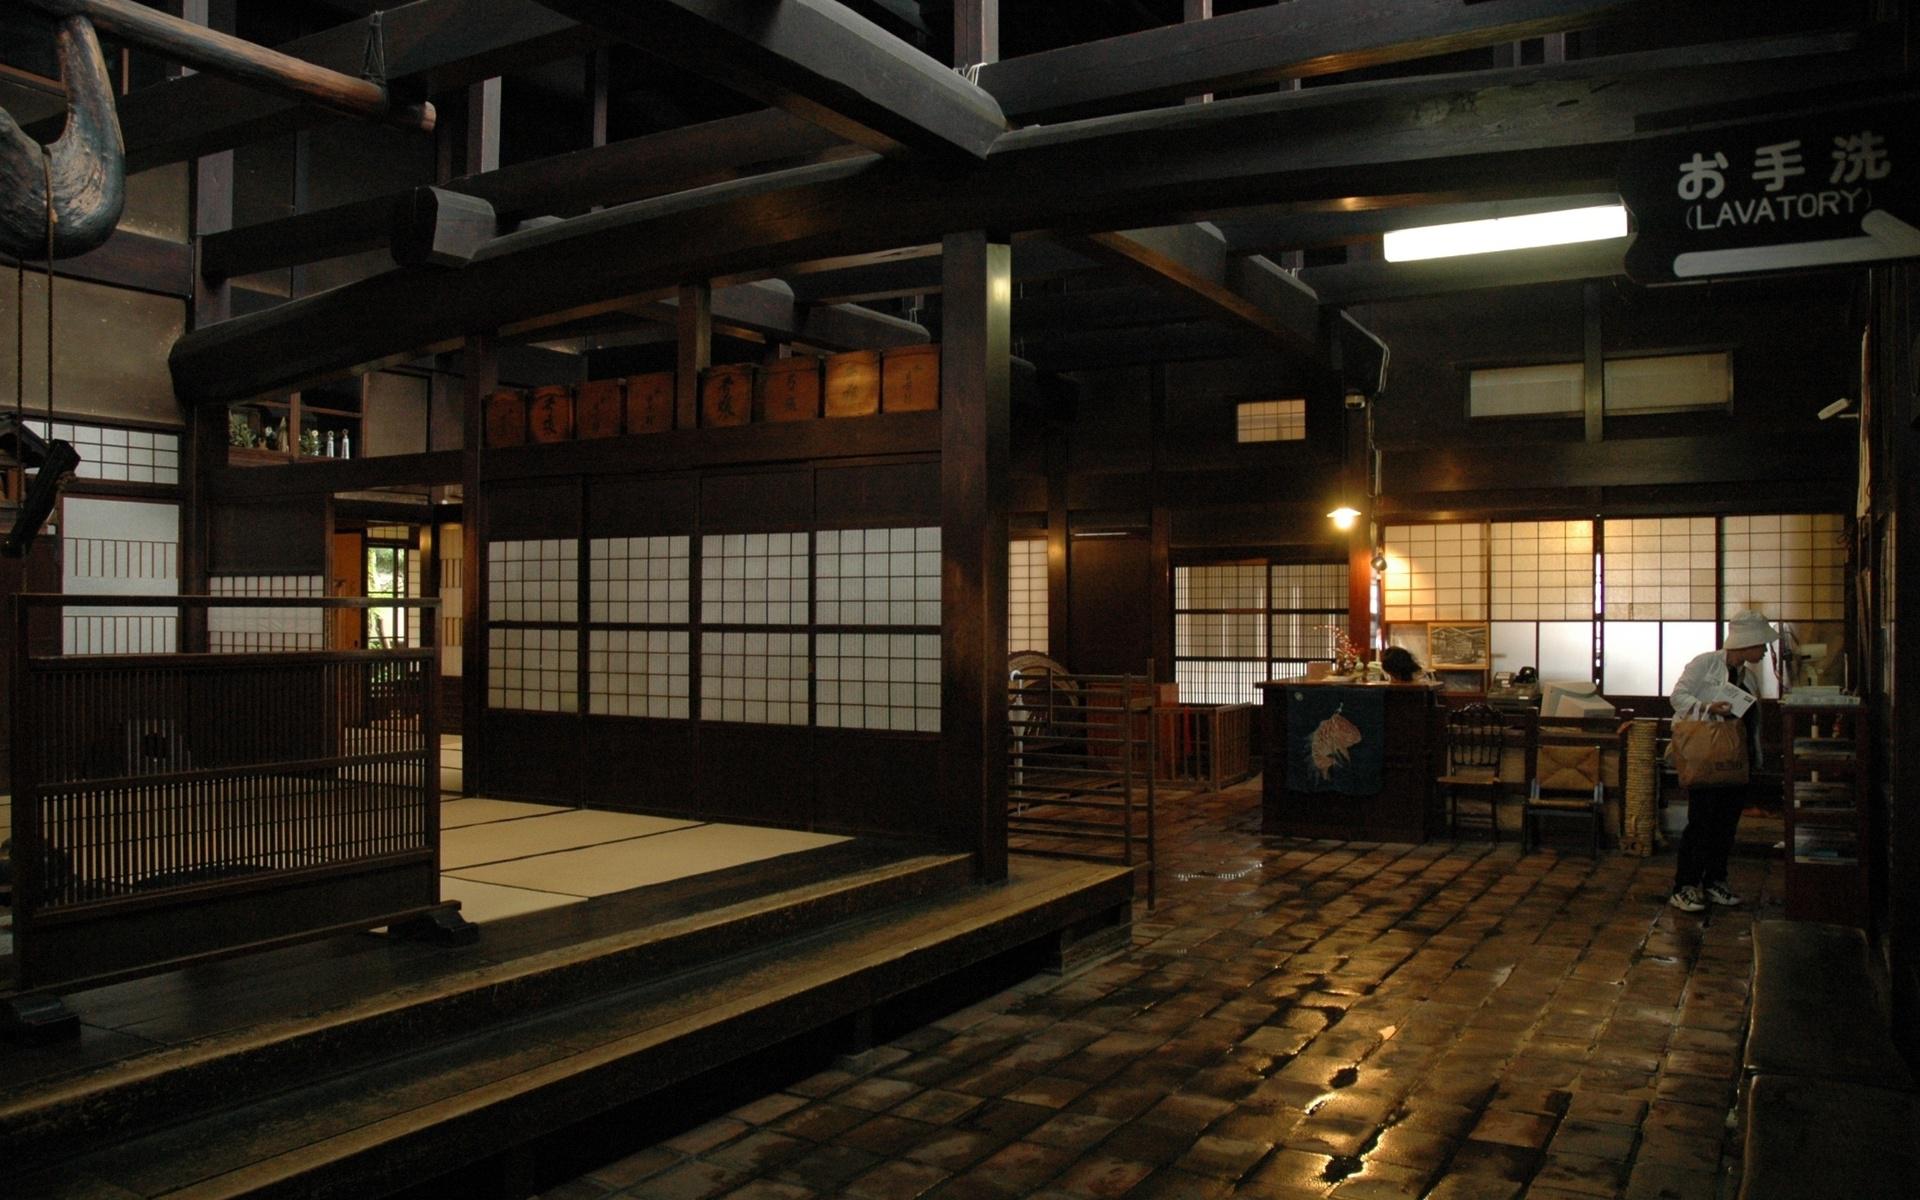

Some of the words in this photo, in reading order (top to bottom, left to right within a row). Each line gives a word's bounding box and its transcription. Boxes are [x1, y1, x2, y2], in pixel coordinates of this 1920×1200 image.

[1677, 130, 1892, 200] お手洗
[1685, 187, 1872, 231] (LAVATORY)
